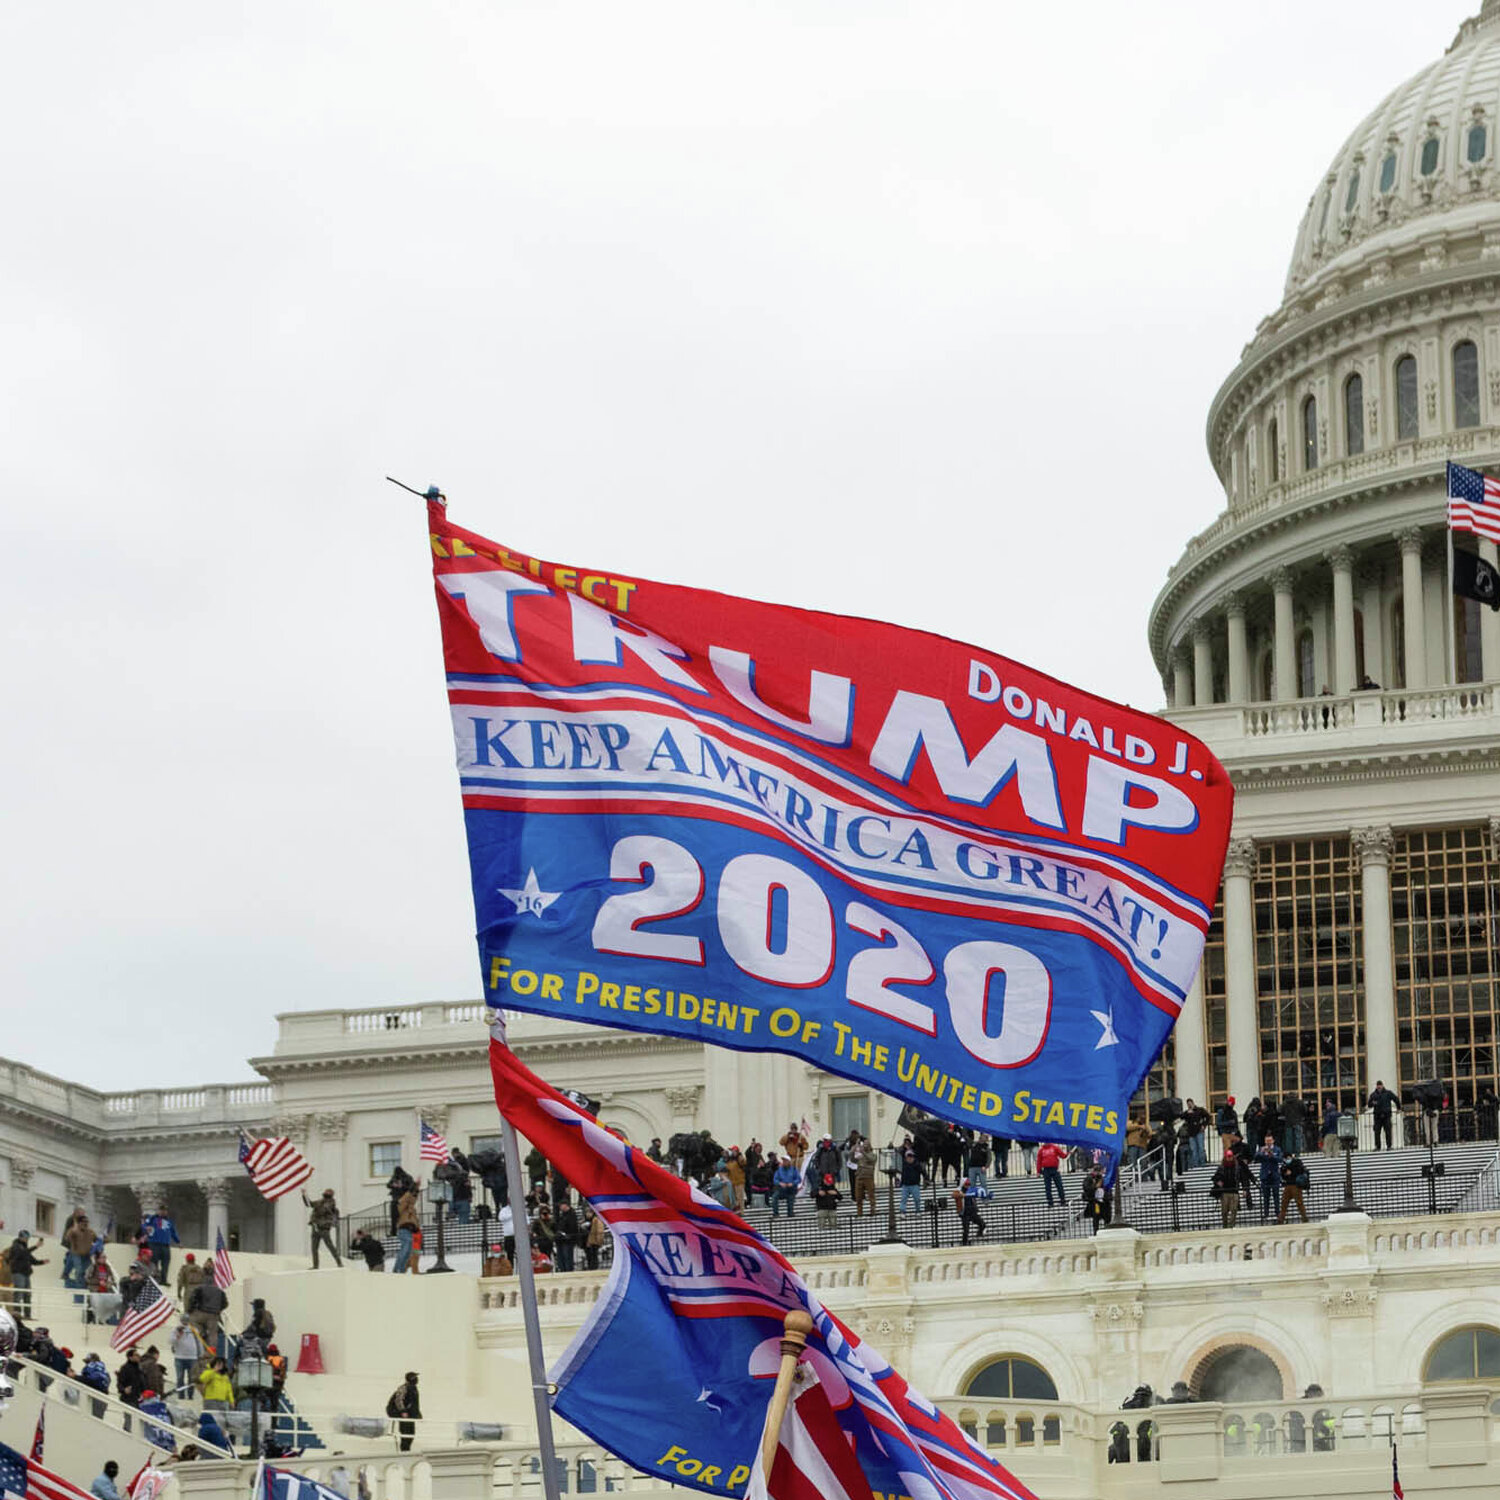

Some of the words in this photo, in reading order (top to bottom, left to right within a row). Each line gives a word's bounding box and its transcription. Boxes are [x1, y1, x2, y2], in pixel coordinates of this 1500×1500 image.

[436, 571, 1201, 846] TRUMP
[968, 659, 1156, 766] DONALD
[468, 717, 630, 772] KEEP
[646, 727, 938, 871] AMERICA
[956, 842, 1170, 961] GREAT!
[591, 835, 1053, 1070] 2020
[621, 1232, 762, 1287] KEEP
